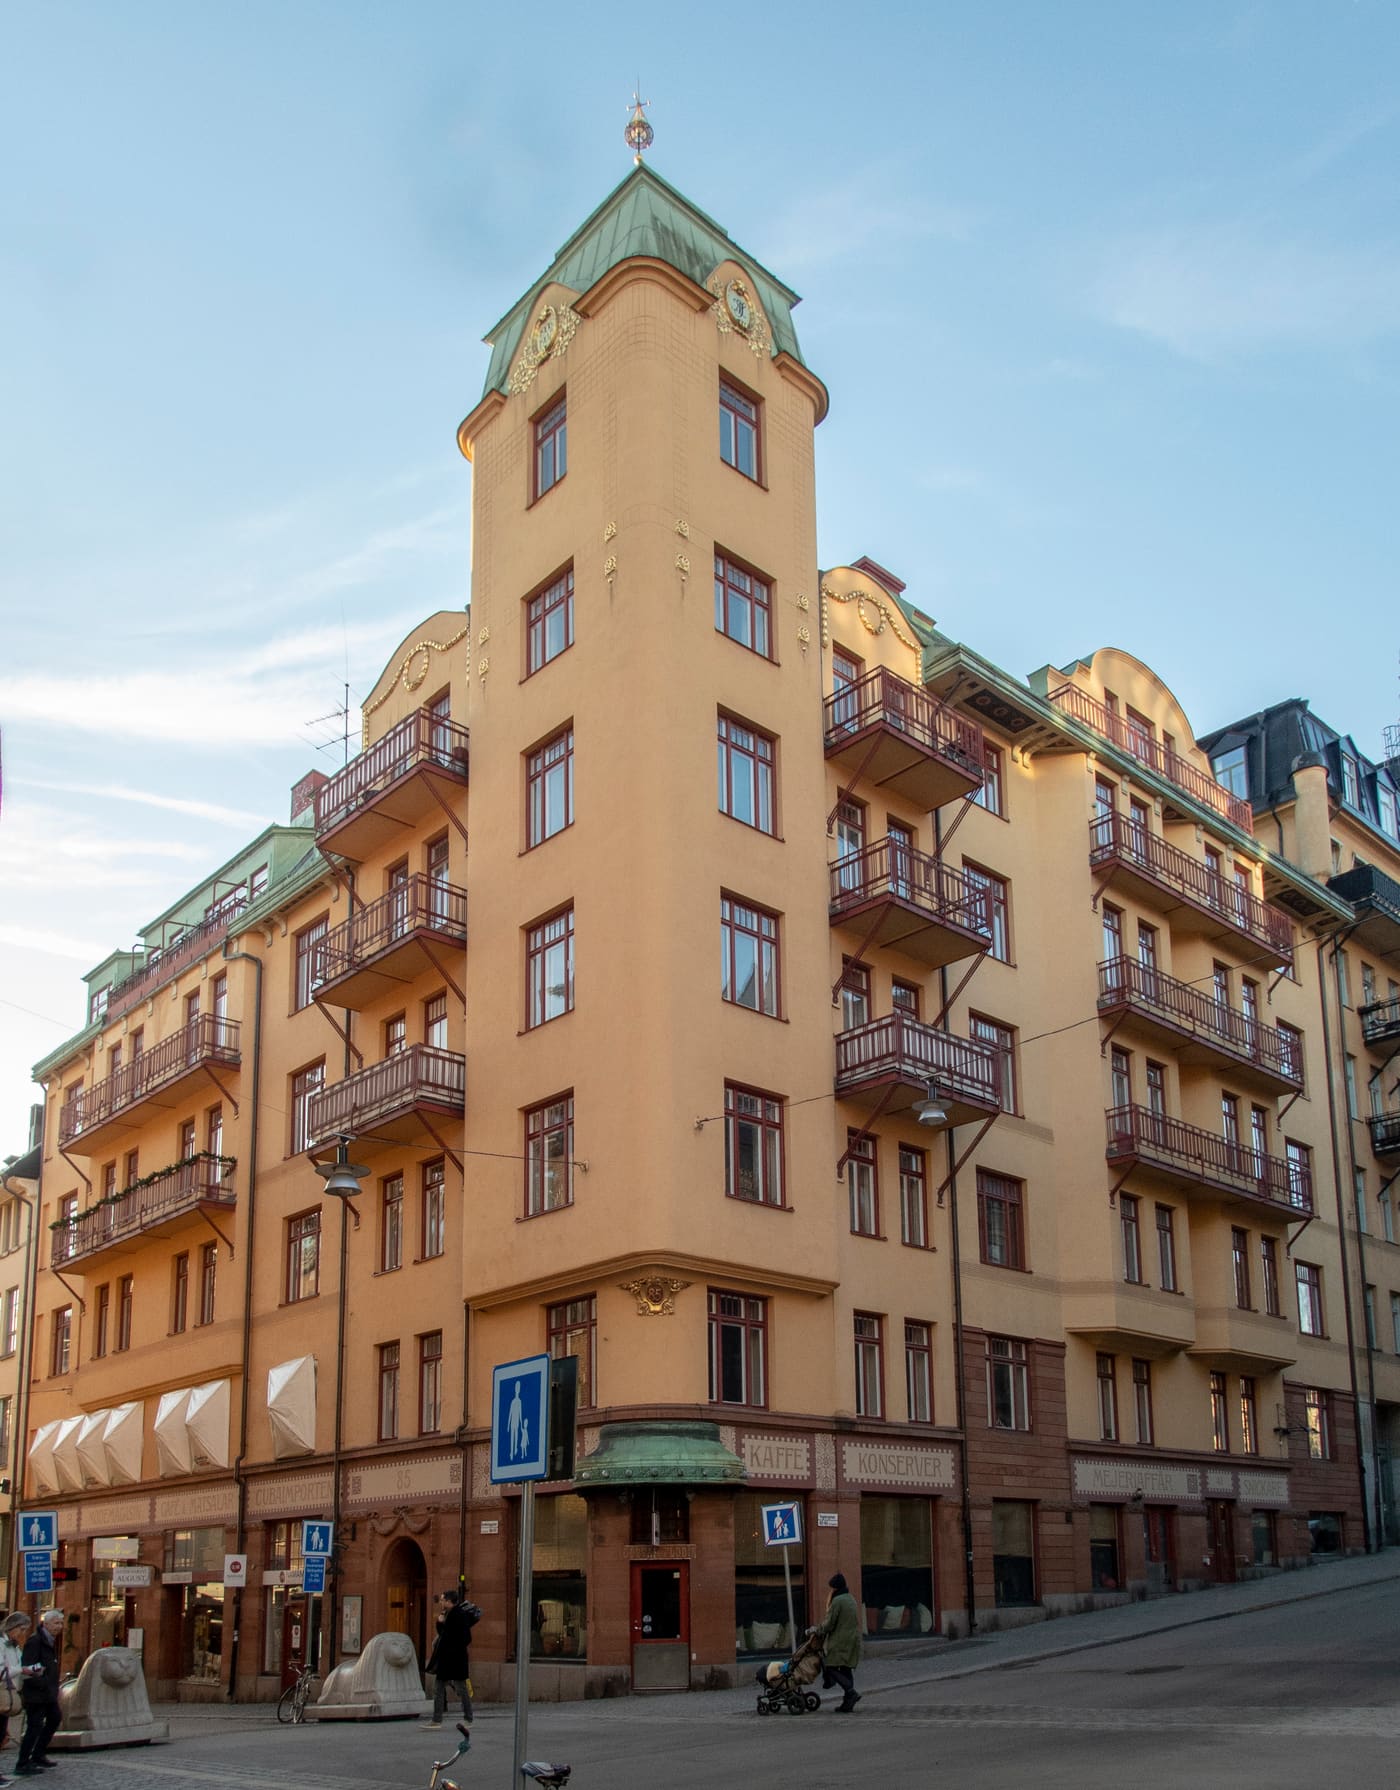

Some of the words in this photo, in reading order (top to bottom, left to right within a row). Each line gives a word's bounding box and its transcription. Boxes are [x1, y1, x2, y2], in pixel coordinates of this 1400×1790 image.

[750, 1445, 805, 1471] KAFFE
[858, 1452, 942, 1479] KONSERVER
[255, 1479, 334, 1506] CUBAIMPORTEN
[396, 1469, 412, 1490] 85
[118, 1574, 146, 1583] AUGUST
